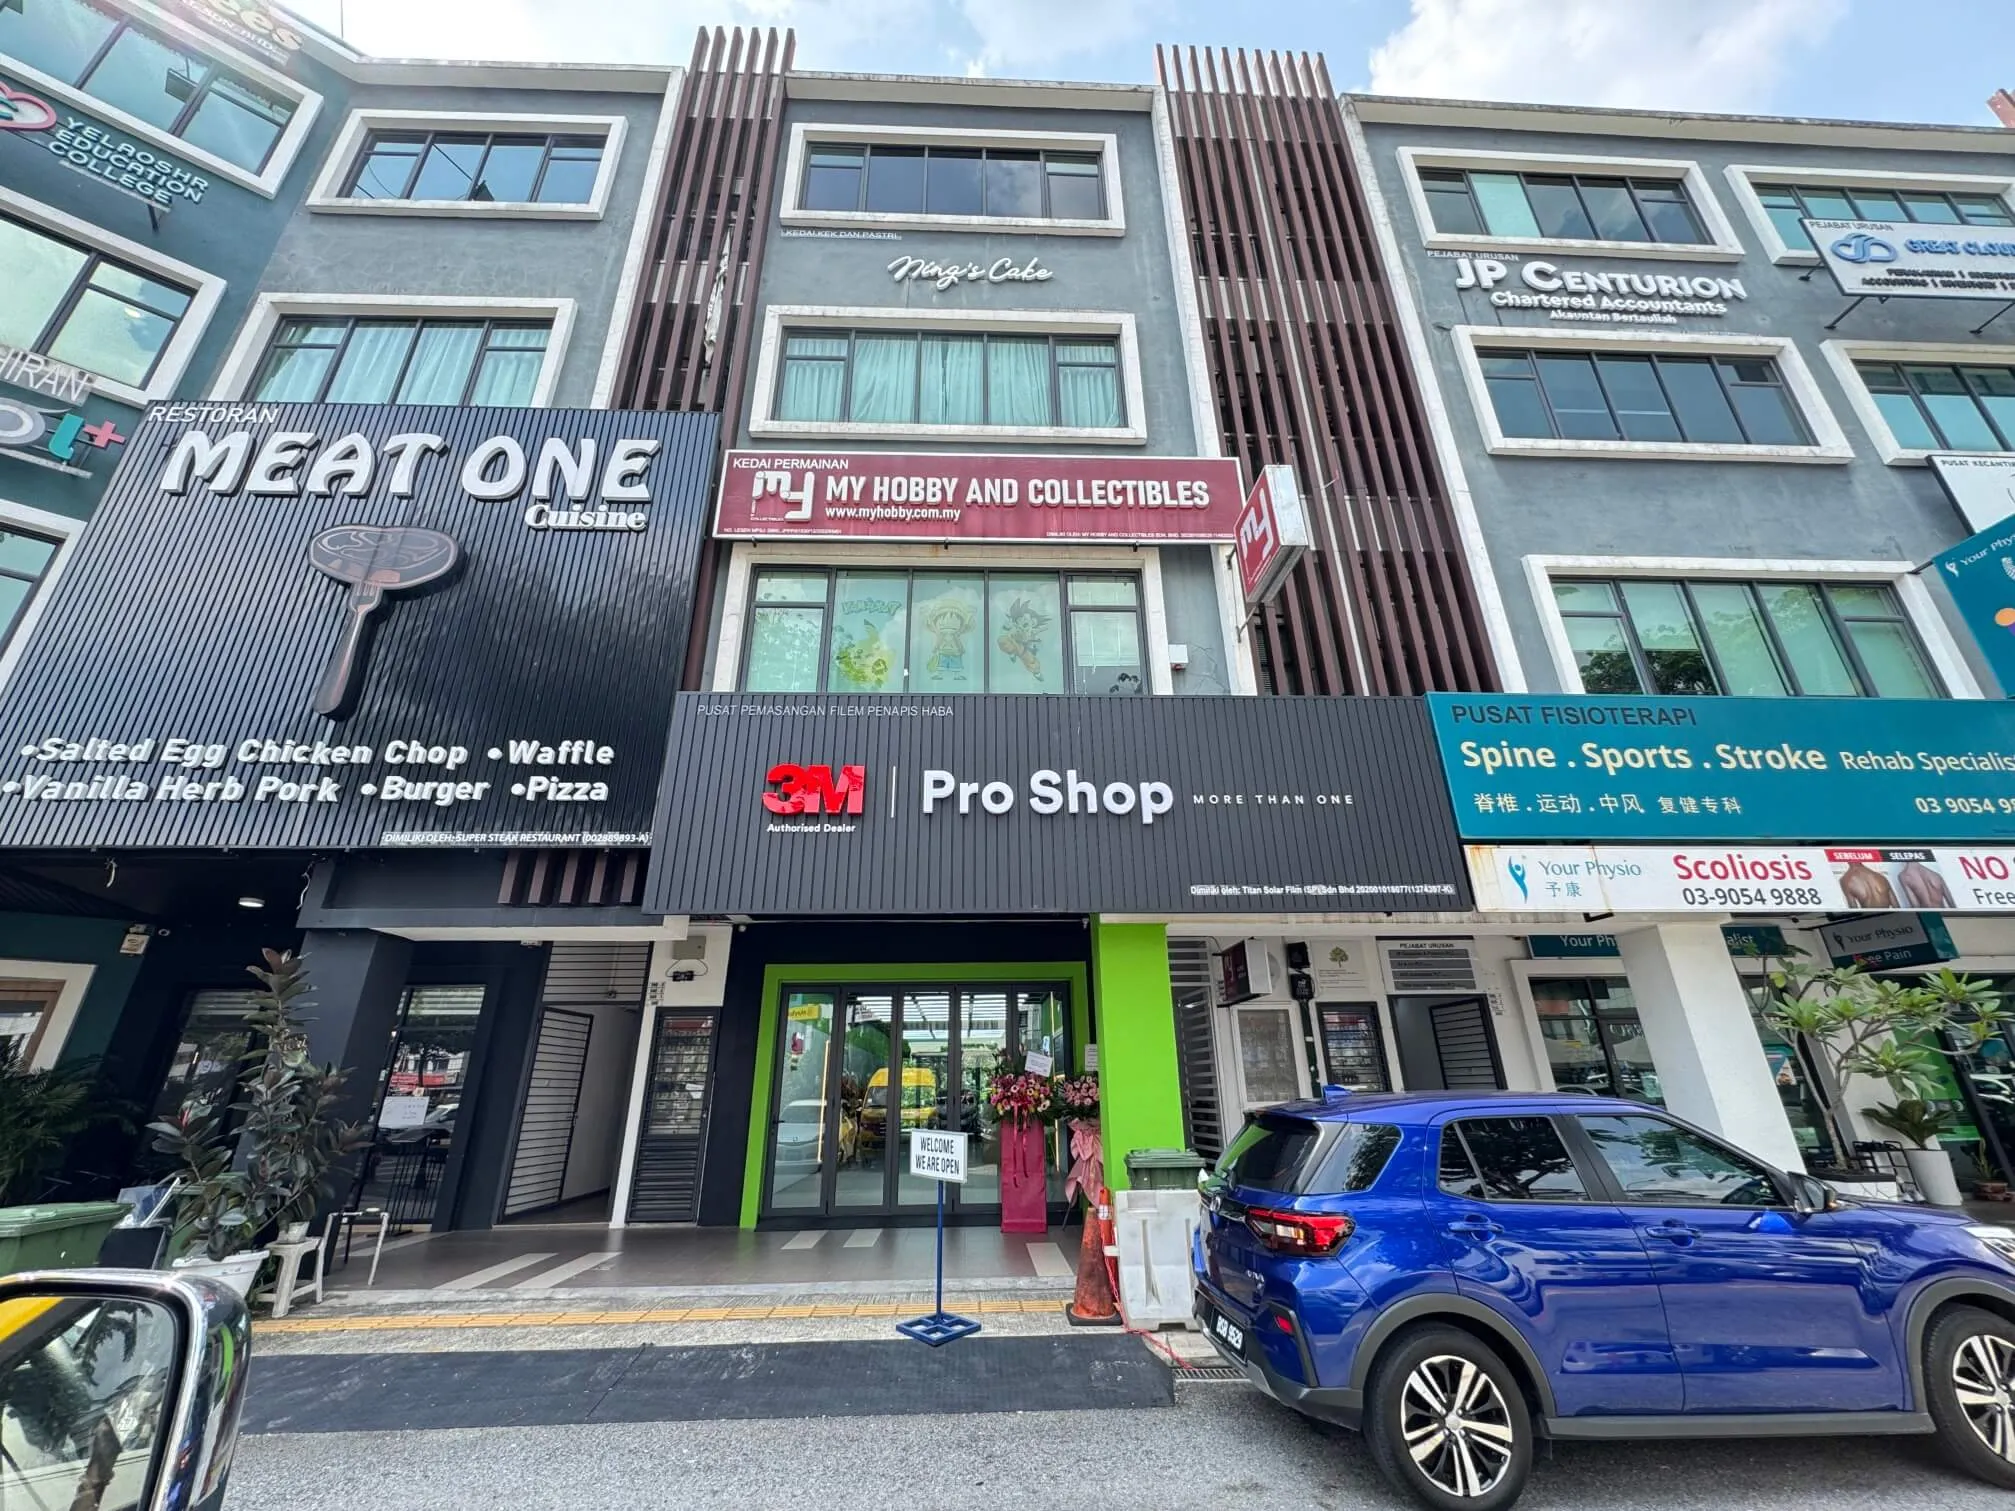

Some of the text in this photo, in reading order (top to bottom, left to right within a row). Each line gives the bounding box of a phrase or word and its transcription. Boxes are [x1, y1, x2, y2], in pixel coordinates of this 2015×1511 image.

[66, 116, 209, 191] YELAOSHR
[48, 141, 173, 205] COLLEGE
[55, 129, 202, 203] EDUCATION
[786, 230, 897, 241] KEDAI KEK DAN PASTRI
[1809, 221, 1894, 232] PEJABAT URUSAN
[1427, 250, 1520, 262] PEJABAT URUSAN
[1905, 238, 1960, 255] GREAT
[987, 257, 1054, 283] Cake
[1455, 258, 1507, 289] JP
[1490, 290, 1728, 316] Chartered Accountants
[1550, 309, 1678, 325] Akauntan Bertauliah
[148, 406, 279, 424] RESTORAN
[160, 430, 661, 501] MEAT ONE
[733, 459, 849, 471] KEDAI PERMAINAN
[1941, 459, 1970, 467] PUSAT
[826, 476, 1210, 508] MY HOBBY AND COLLECTIBLES
[525, 503, 647, 532] Cuisine
[825, 506, 961, 522] www.myhobby.com.my
[1960, 548, 1988, 567] Your
[697, 704, 954, 718] PUSAT PEMASANGAN FILEM PENAPIS HABA
[1452, 705, 1697, 726] PUSAT FISIOTERAPI
[36, 737, 615, 770] Salted Egg Chicken Chop Waffle
[1460, 740, 2015, 776] Spine Sports Stroke Rehab Specialis
[23, 774, 609, 806] Vanilla Herb Pork Burger Pizza
[762, 763, 866, 817] 3M
[923, 769, 1174, 824] Pro Shop
[1193, 794, 1355, 805] MORE THAN ONE
[1473, 793, 1520, 814] 脊椎
[1536, 793, 1582, 814] 运动
[1914, 797, 1942, 814] 03
[1945, 797, 1996, 814] 9054
[767, 823, 856, 833] Authorised Dealer
[455, 833, 487, 843] SUPER
[487, 833, 518, 843] STEAK
[519, 833, 581, 843] RESTAURANT
[1832, 851, 1925, 861] SEBELUM SELEPAS
[1538, 860, 1642, 880] Your Physio
[1673, 853, 1813, 881] Scoliosis
[1958, 856, 2009, 880] NO
[1242, 885, 1262, 895] Titan
[1263, 885, 1284, 895] Solar
[1285, 885, 1303, 895] Film
[1338, 885, 1355, 895] Bhd
[1682, 887, 1822, 906] 03-9054 9888
[1973, 888, 2015, 905] Free
[1559, 935, 1617, 948] Your Ph
[1874, 925, 1913, 940] Physio
[1885, 948, 1912, 960] Pain
[920, 1136, 955, 1155] WELCOME
[915, 1153, 960, 1175] WE ARE OPEN
